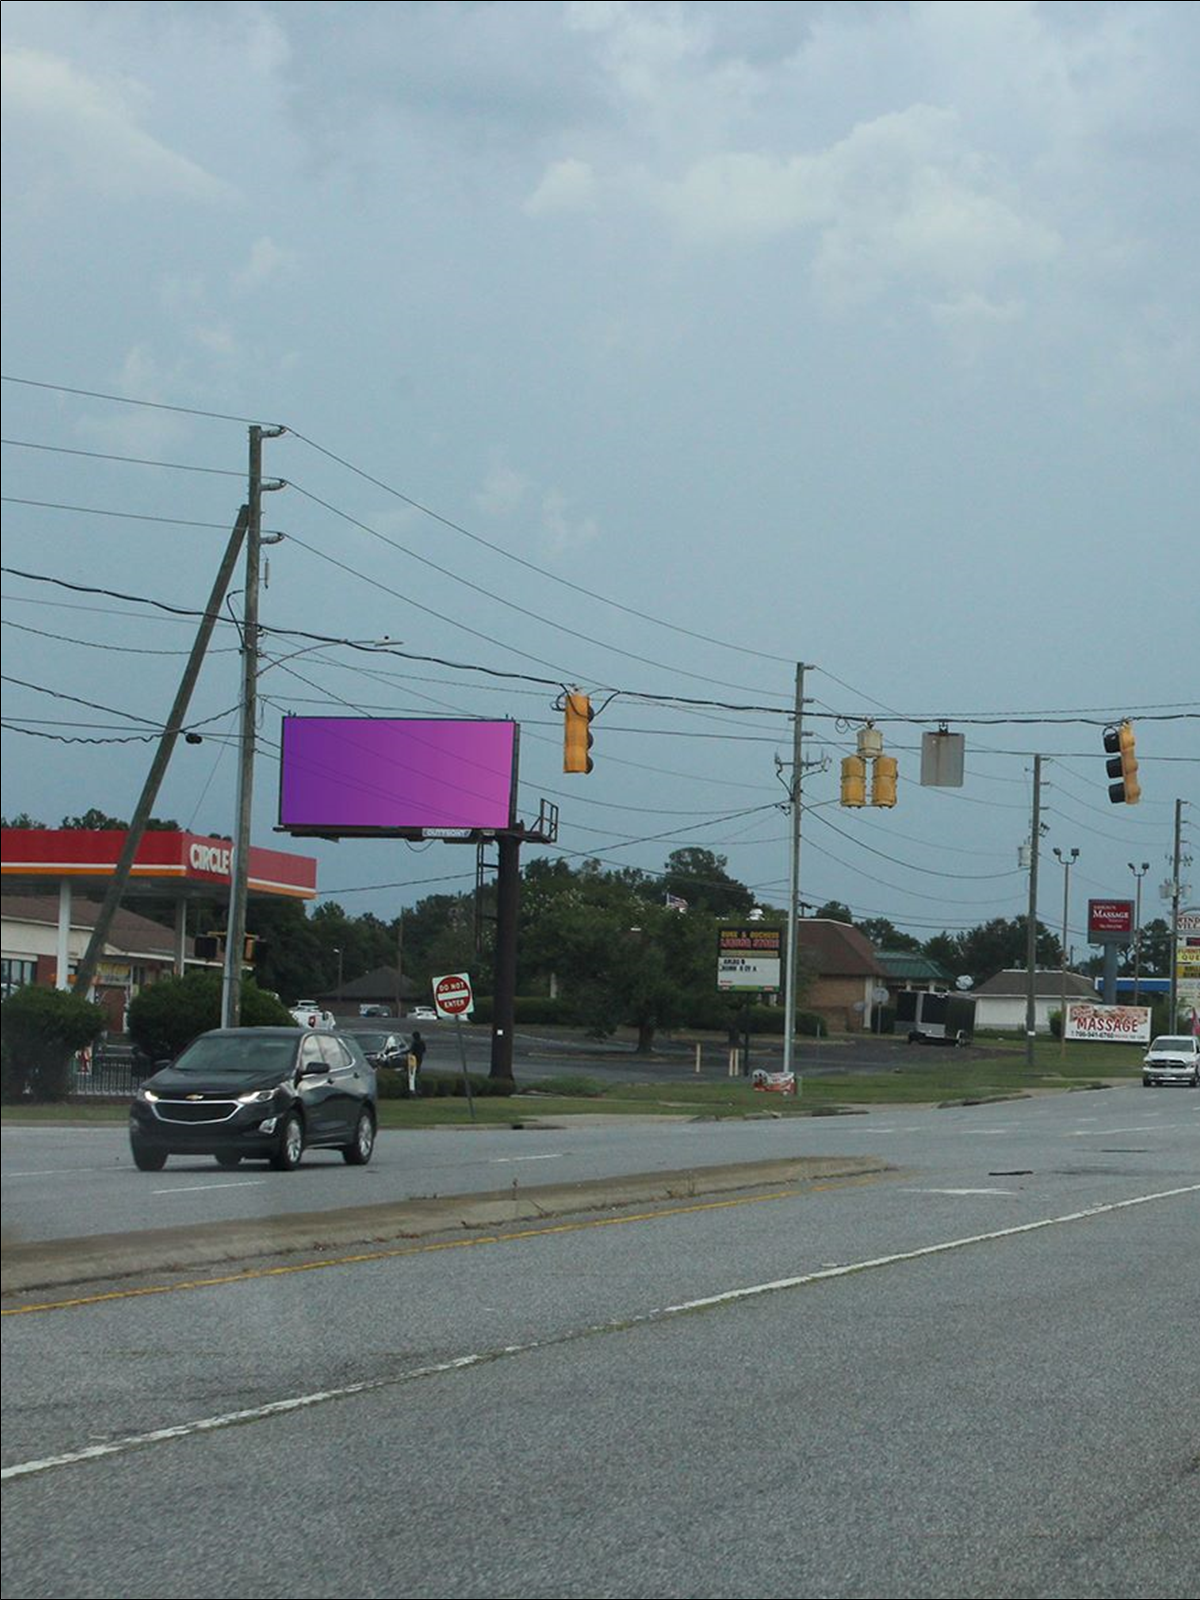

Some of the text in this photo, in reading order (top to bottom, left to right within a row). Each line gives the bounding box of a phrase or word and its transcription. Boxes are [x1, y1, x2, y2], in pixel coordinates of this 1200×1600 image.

[189, 843, 230, 875] CIRCLE
[450, 981, 464, 990] NOT
[444, 999, 465, 1008] ENTER
[1076, 1017, 1139, 1032] MASSAGE
